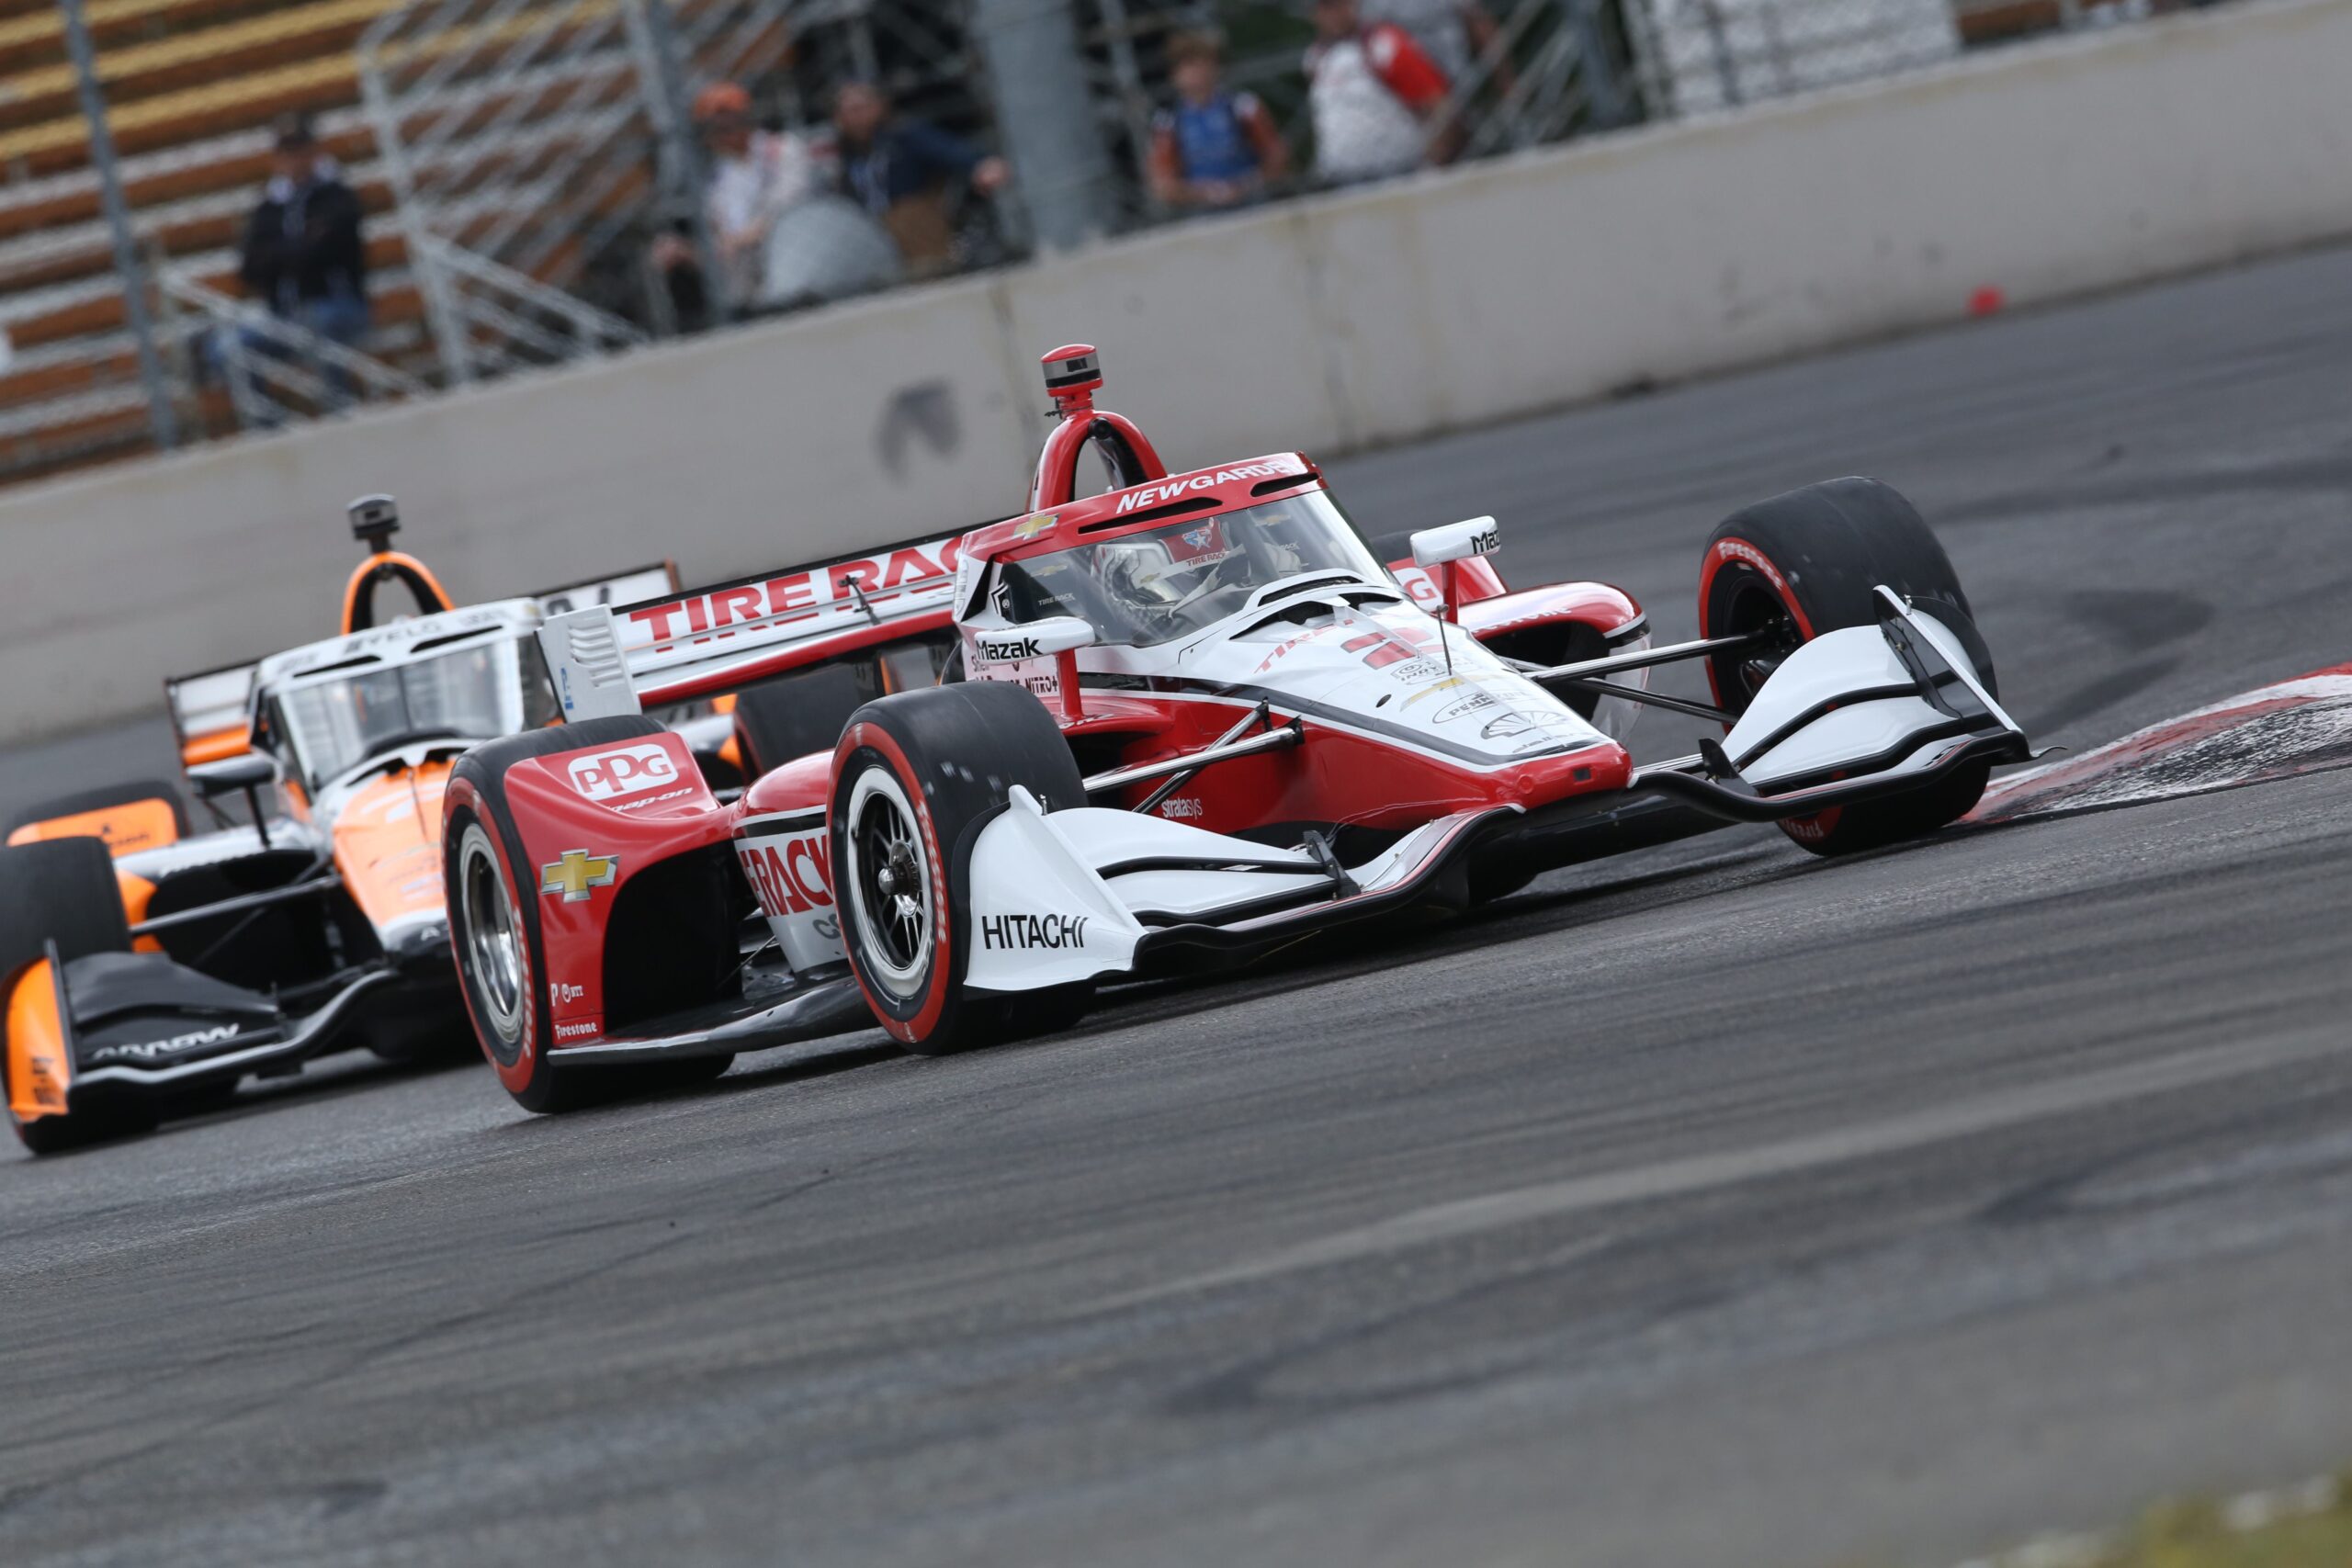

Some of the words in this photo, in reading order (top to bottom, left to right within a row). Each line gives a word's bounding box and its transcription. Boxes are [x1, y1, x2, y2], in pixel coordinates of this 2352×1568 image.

[628, 571, 819, 650] TIRE
[976, 637, 1043, 660] Mazak
[575, 753, 672, 794] PPG
[1161, 795, 1204, 820] stratasys
[981, 913, 1090, 950] HITACHI
[554, 1022, 598, 1040] Firestone
